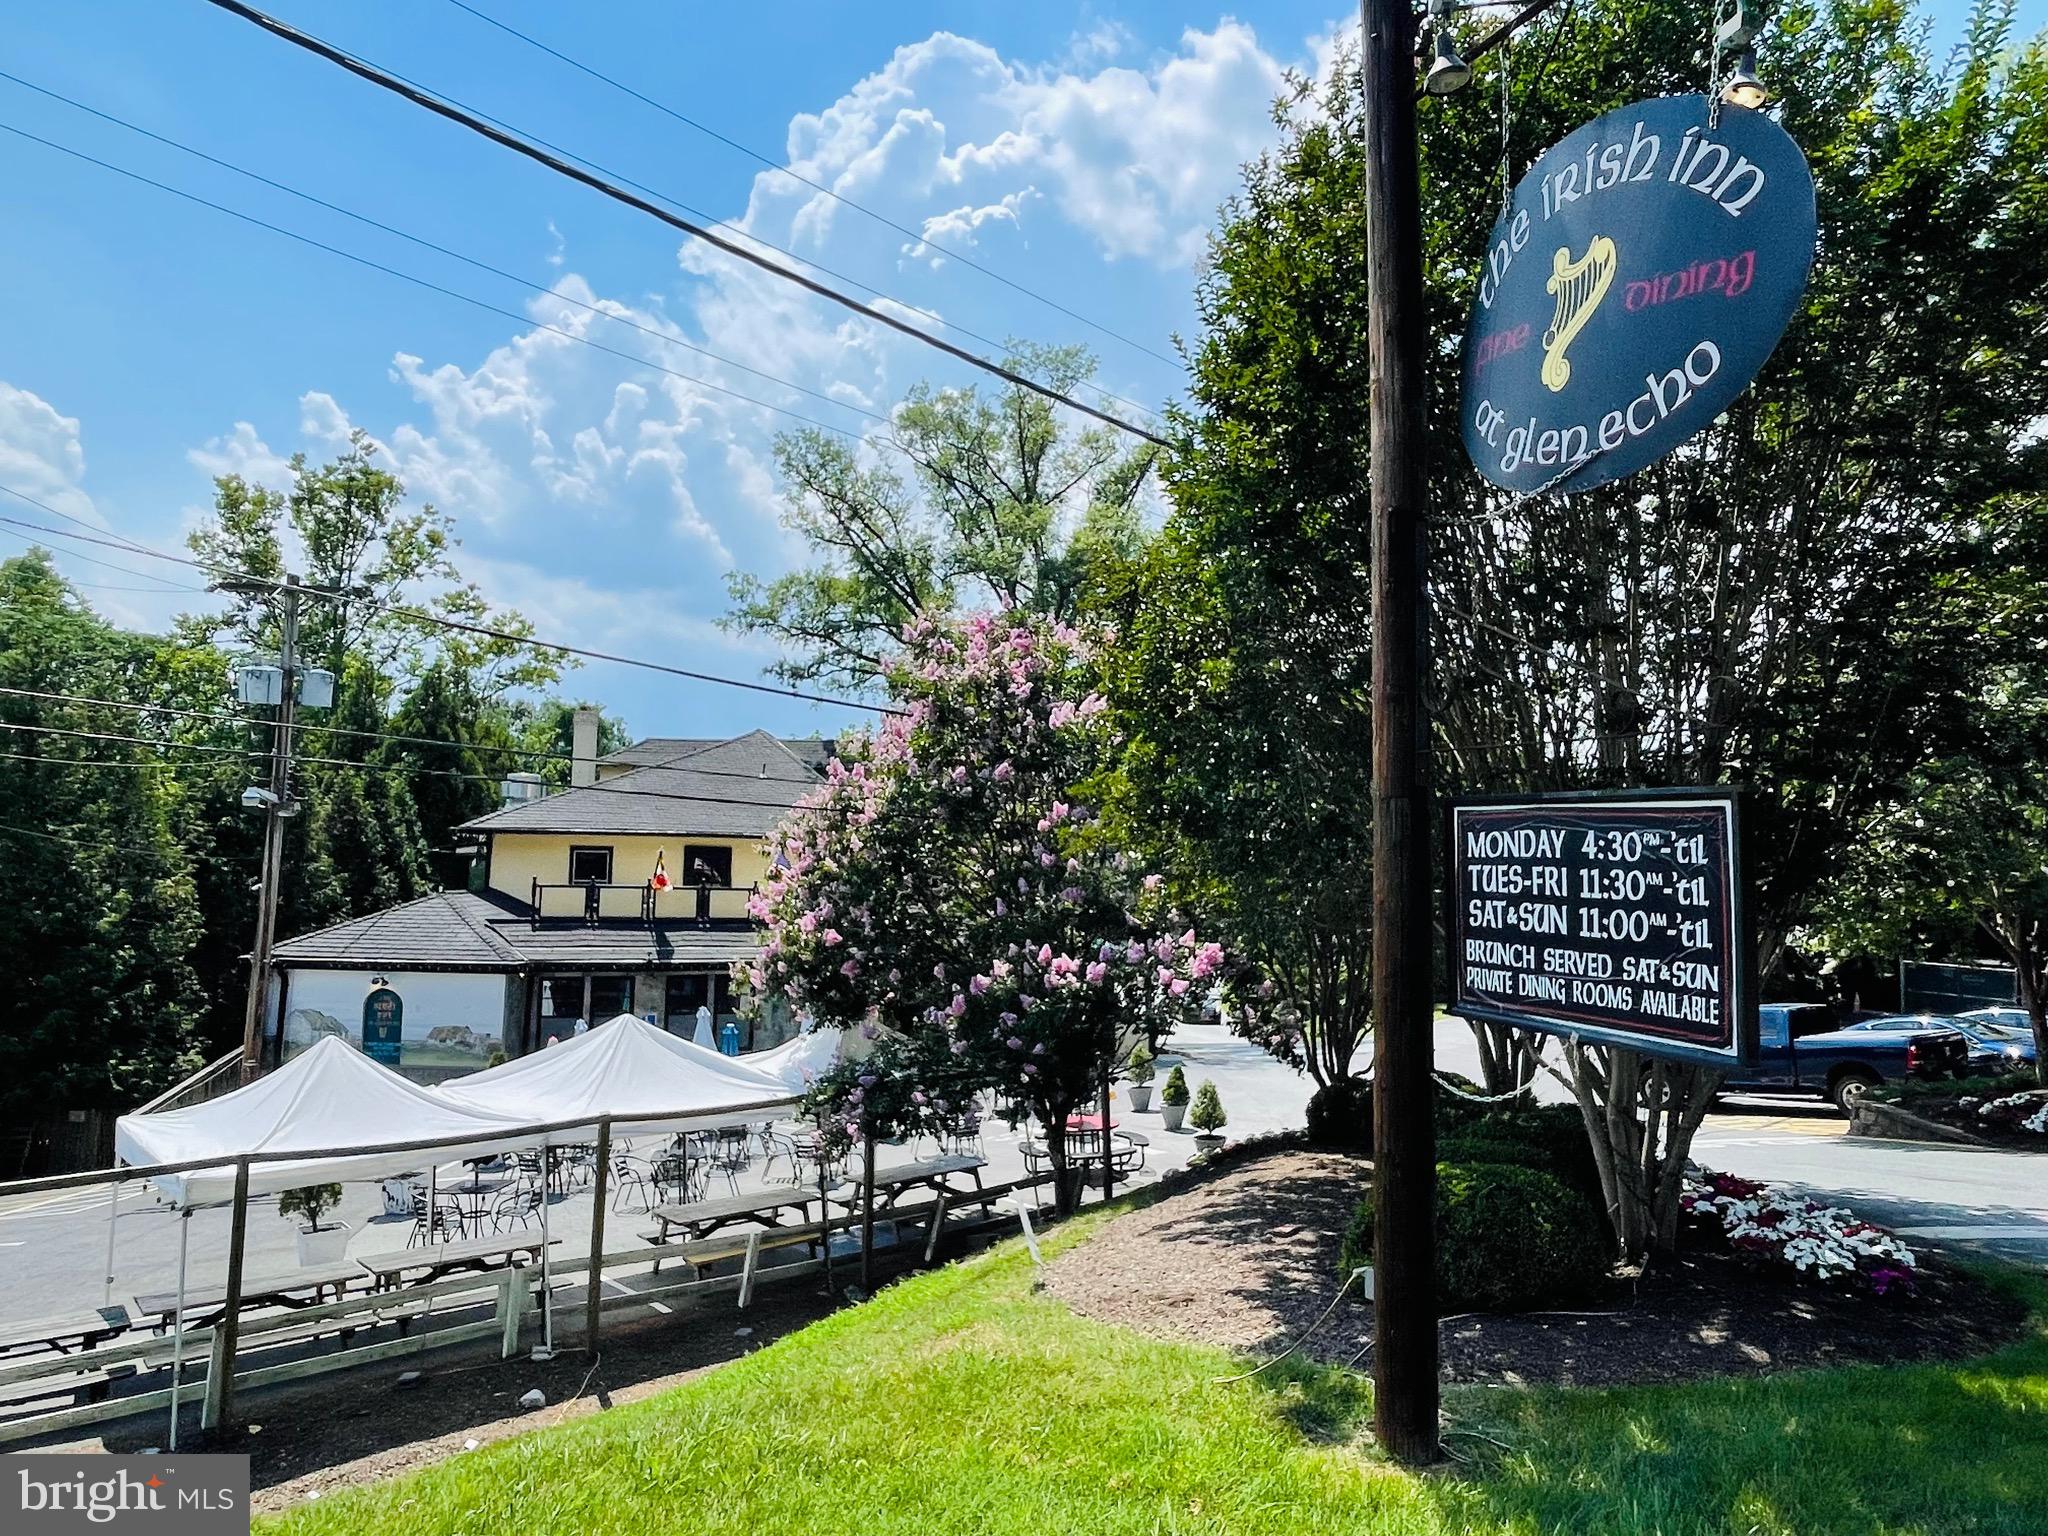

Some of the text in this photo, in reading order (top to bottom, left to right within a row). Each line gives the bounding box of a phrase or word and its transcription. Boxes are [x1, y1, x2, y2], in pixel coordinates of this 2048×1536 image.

[1466, 829, 1566, 859] MONDAY
[1468, 864, 1568, 898] TUES-FRI
[1466, 939, 1535, 969] BRUNCH
[1543, 948, 1613, 978] SERVED
[1466, 966, 1719, 1025] PRIVATE DINING ROOMS AVAILABLE
